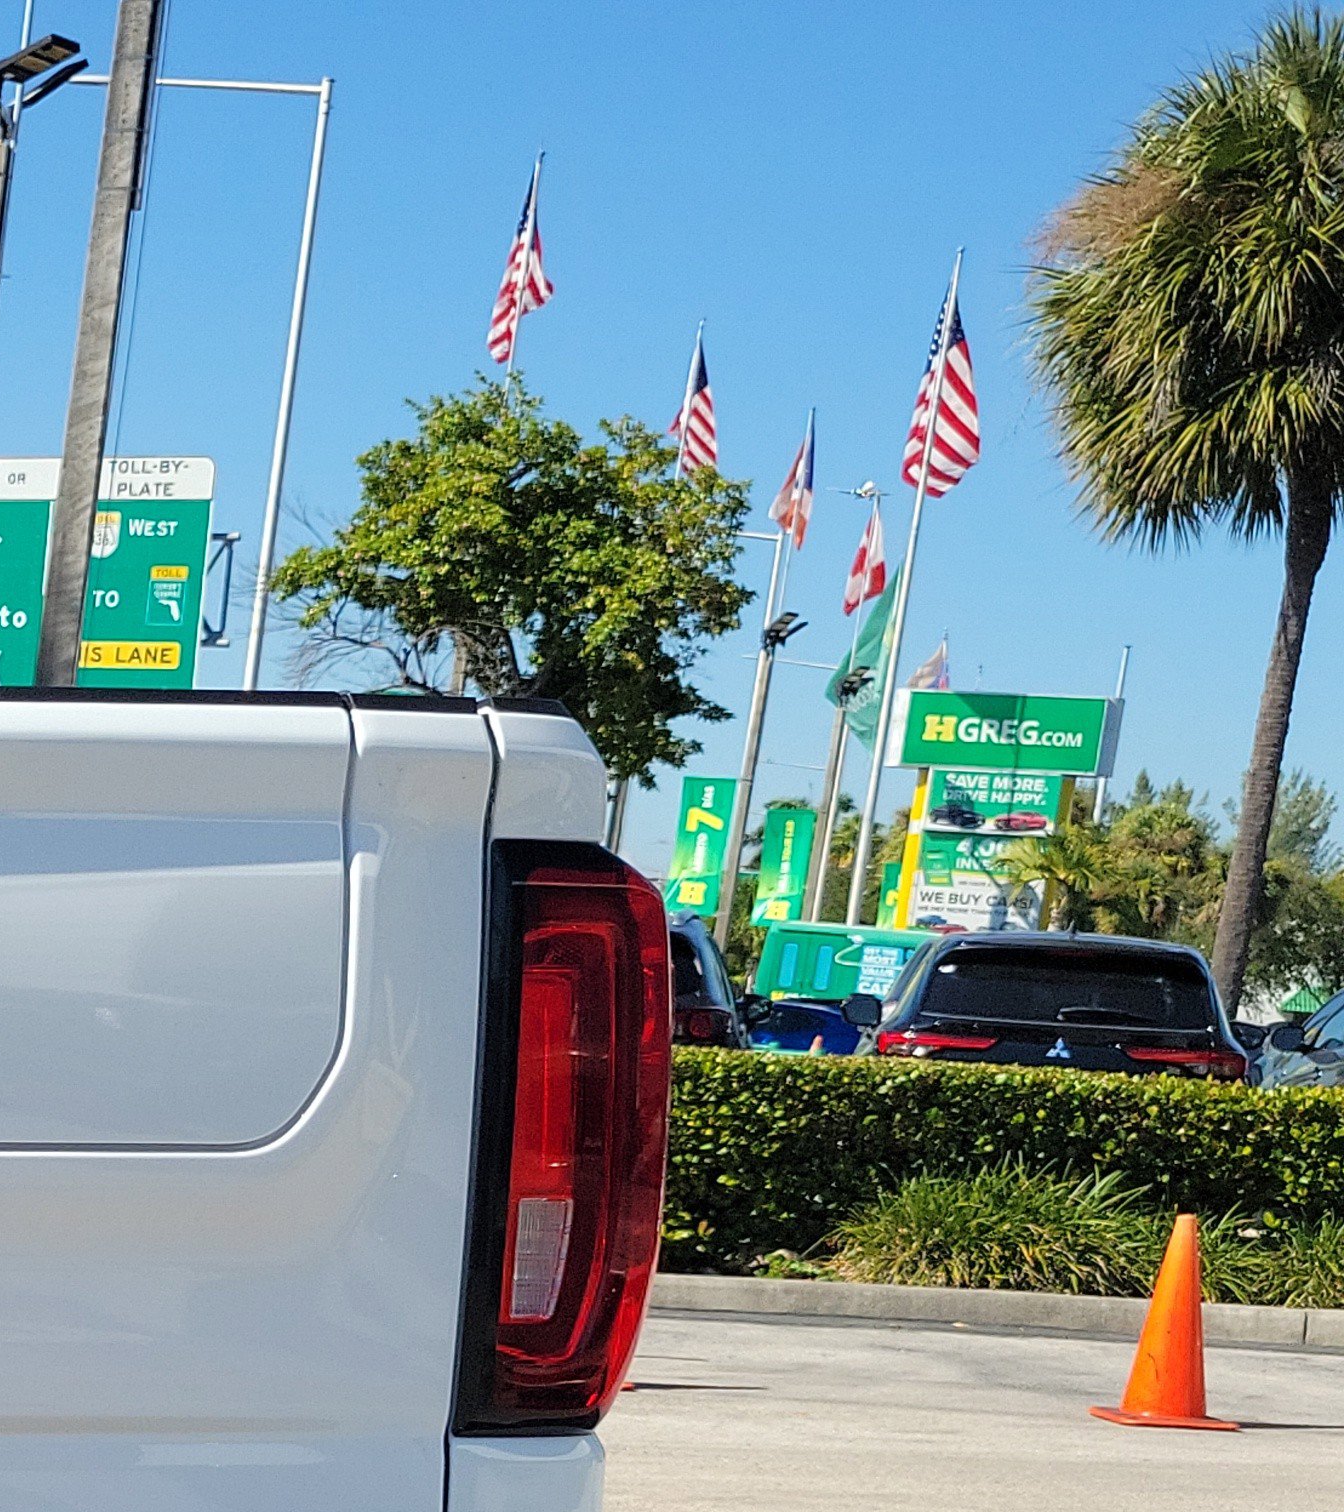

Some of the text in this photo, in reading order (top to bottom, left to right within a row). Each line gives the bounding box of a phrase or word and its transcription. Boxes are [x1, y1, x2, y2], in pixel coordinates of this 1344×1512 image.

[109, 460, 189, 475] TOLL-BY-
[7, 473, 26, 485] OR
[116, 482, 176, 497] PLATE
[128, 518, 179, 537] WEST
[155, 568, 182, 578] TOLL
[92, 589, 120, 608] TO
[115, 646, 174, 664] LANE
[921, 714, 1083, 748] HGREG.COM
[945, 773, 1049, 793] SAVE MORE.
[942, 788, 1047, 806] DRIVE HAPPY.
[685, 807, 725, 833] 7
[919, 890, 945, 905] WE
[948, 892, 984, 907] BUY
